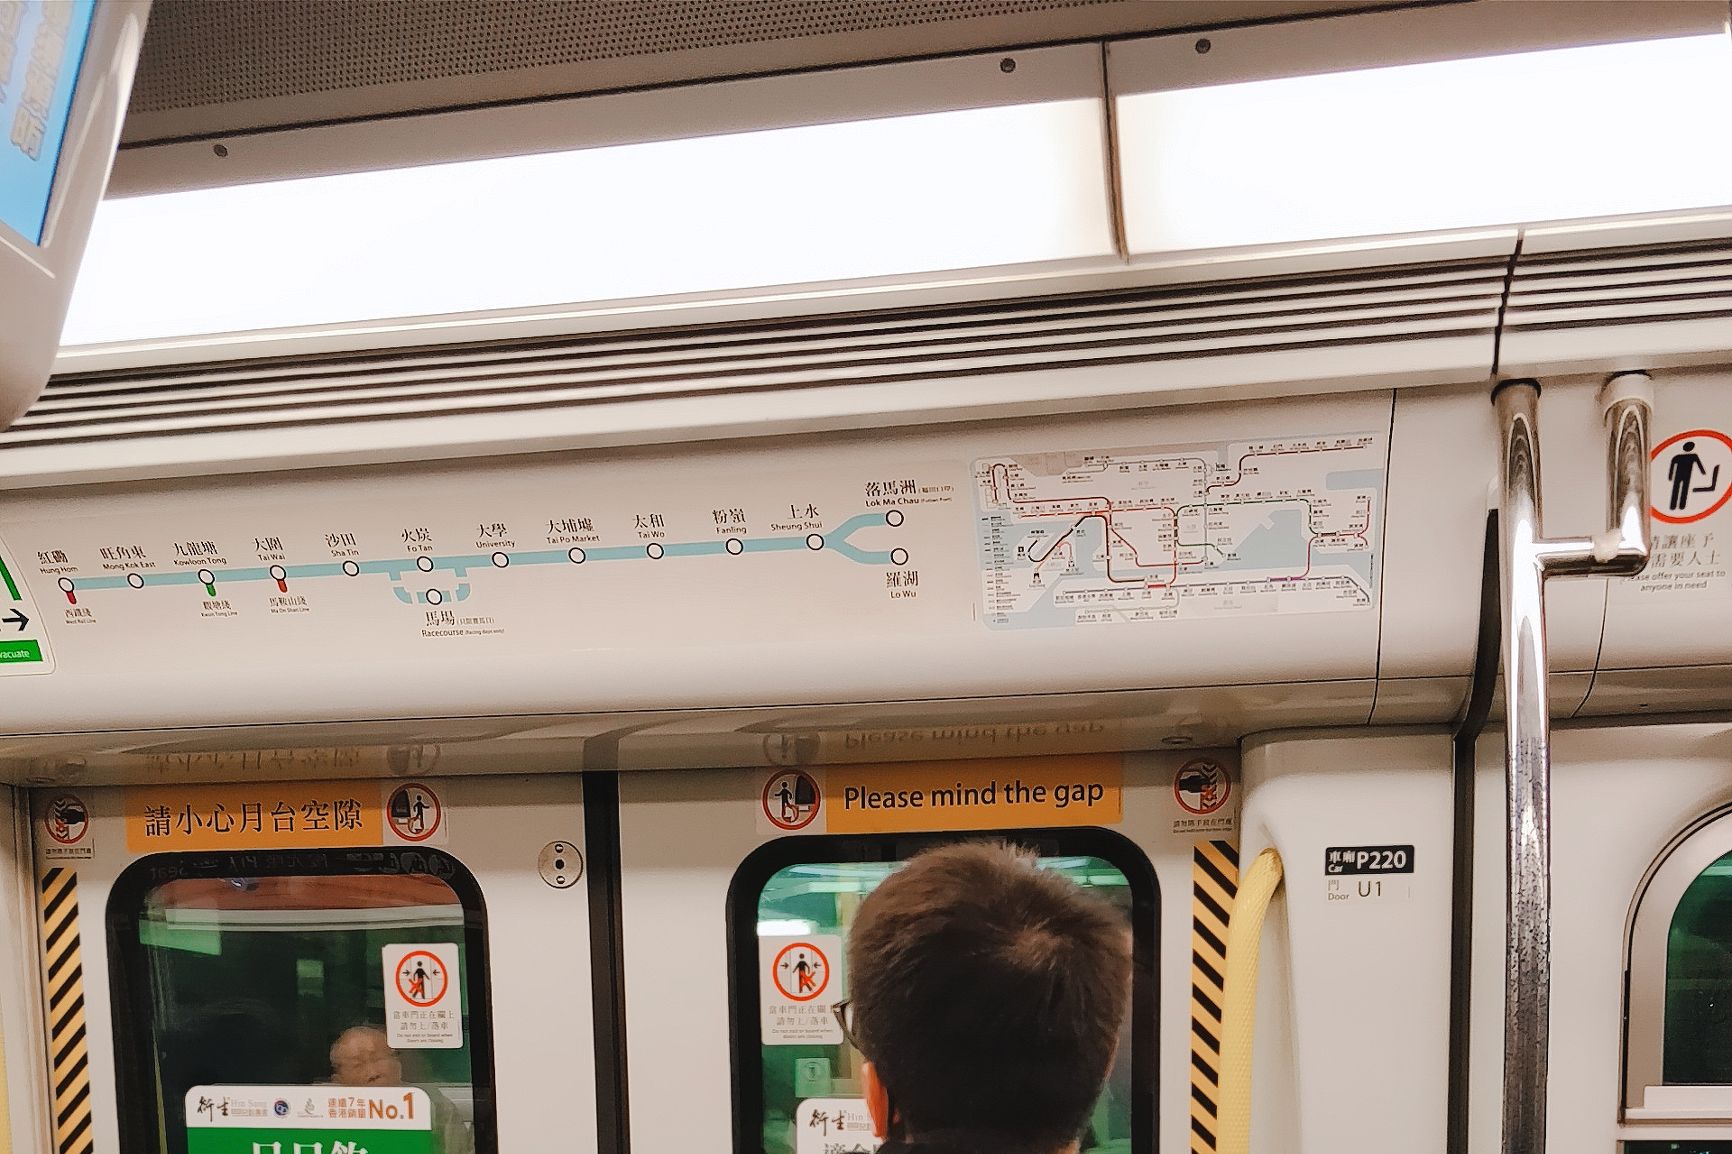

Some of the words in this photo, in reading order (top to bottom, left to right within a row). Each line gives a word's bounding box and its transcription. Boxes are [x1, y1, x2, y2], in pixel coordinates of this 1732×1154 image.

[864, 479, 918, 497] 落馬洲
[865, 499, 881, 508] Lok
[882, 498, 896, 506] Ma
[897, 496, 920, 505] Chau
[712, 508, 746, 524] 粉嶺
[787, 503, 819, 520] 上水
[545, 518, 594, 534] 大埔墟
[632, 513, 665, 529] 太和
[770, 523, 802, 532] Sheung
[803, 521, 823, 529] Shui
[401, 528, 432, 543] 火炭
[476, 523, 509, 539] 大學
[651, 530, 665, 538] Wo
[716, 526, 747, 535] Fanling
[253, 536, 283, 551] 大圍
[324, 532, 357, 548] 沙田
[475, 539, 516, 549] University
[547, 536, 558, 544] Tai
[559, 535, 571, 543] Po
[572, 534, 600, 543] Market
[100, 545, 147, 560] 旺角東
[172, 541, 218, 556] 九龍塘
[417, 544, 433, 552] Tan
[38, 550, 68, 565] 紅磡
[174, 558, 205, 566] Kowloon
[207, 556, 227, 565] Tong
[258, 553, 270, 561] Tai
[271, 552, 285, 561] Wai
[40, 567, 58, 575] Hung
[103, 562, 125, 571] Mong
[140, 561, 156, 569] East
[886, 570, 919, 588] 羅湖
[1651, 572, 1672, 580] offer
[1675, 571, 1694, 580] your
[1697, 569, 1714, 578] seat
[1716, 569, 1726, 577] to
[890, 590, 901, 599] Lo
[903, 589, 917, 598] Wu
[1641, 583, 1672, 592] anyone
[1674, 582, 1683, 590] in
[1685, 581, 1707, 589] need
[425, 610, 455, 626] 馬場
[421, 627, 464, 637] Racecourse
[845, 786, 923, 810] Please
[931, 781, 996, 806] mind
[1004, 778, 1046, 802] the
[1055, 781, 1104, 808] gap
[144, 799, 362, 837] 請小心月台空隙
[1357, 850, 1407, 869] P220
[1328, 893, 1349, 901] Door
[369, 1092, 414, 1119] No.1
